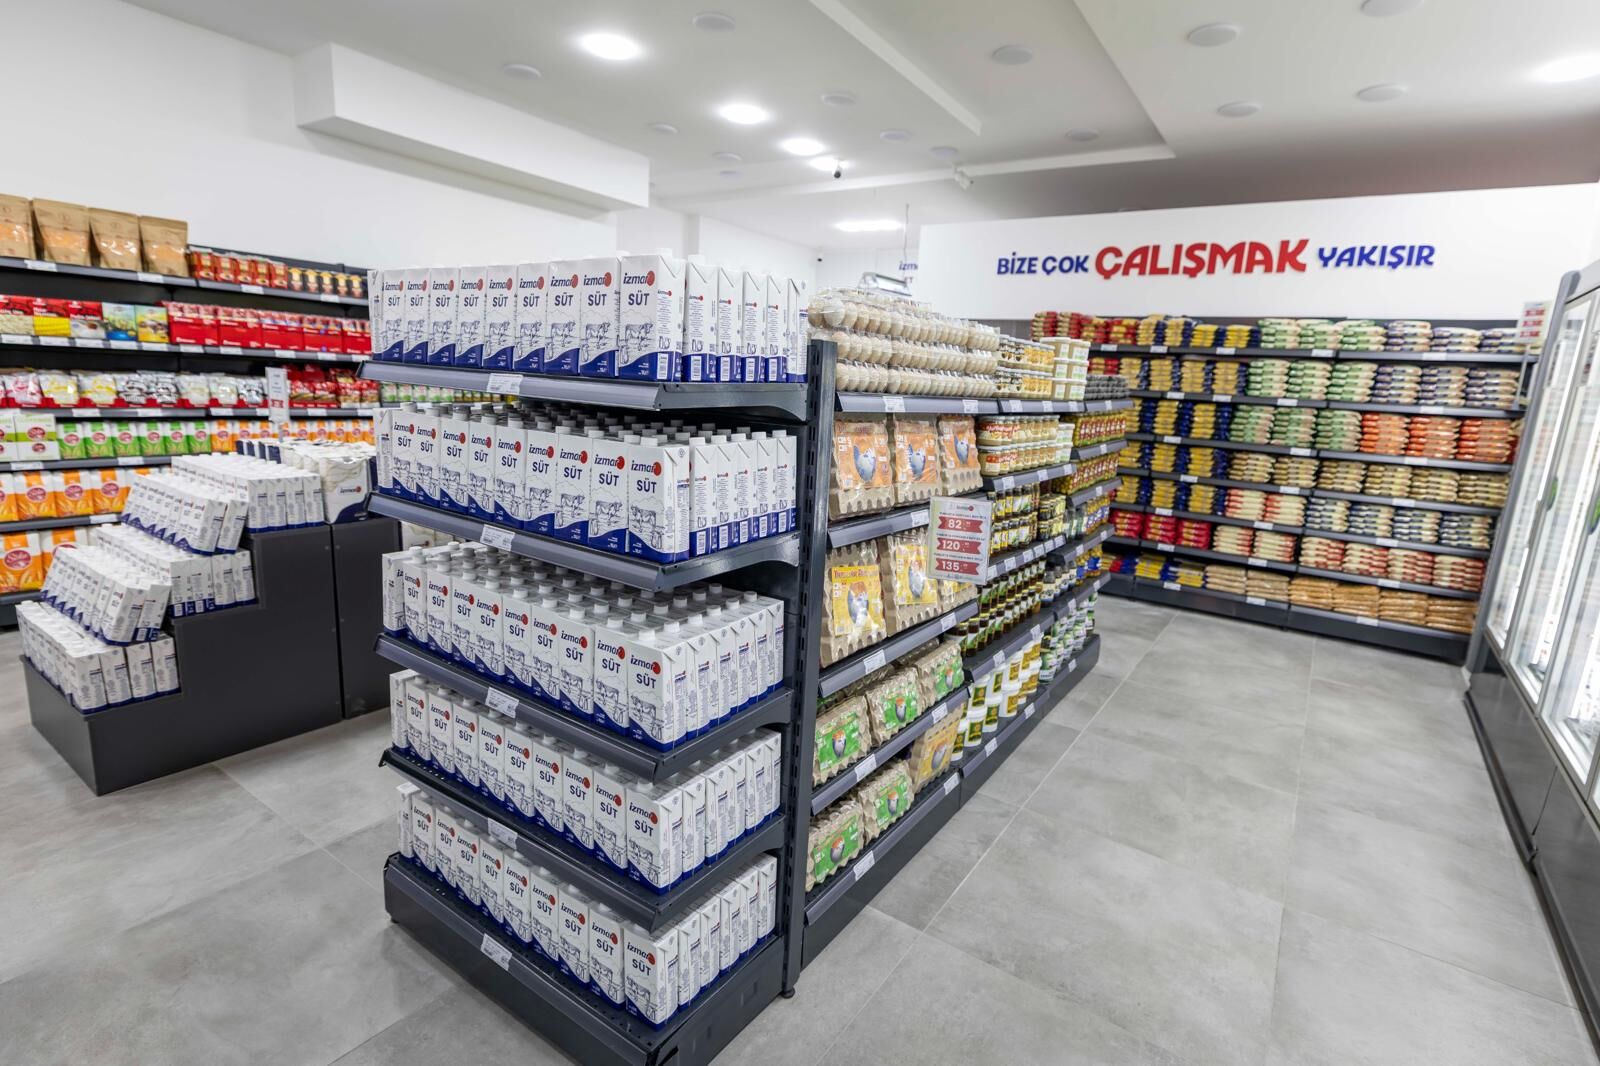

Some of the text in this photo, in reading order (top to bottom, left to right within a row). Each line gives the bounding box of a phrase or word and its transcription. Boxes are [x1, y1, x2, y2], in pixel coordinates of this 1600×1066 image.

[997, 238, 1435, 280] BİZE ÇOK ÇALIŞMAK YAKIŞIR
[388, 295, 400, 306] SÜT
[410, 295, 424, 306] SÜT
[436, 295, 450, 307] SÜT
[464, 294, 479, 307] SÜT
[493, 294, 508, 307] SÜT
[523, 294, 540, 307] SÜT
[555, 292, 573, 306] SÜT
[588, 291, 607, 306] SÜT
[628, 290, 650, 305] SÜT
[398, 436, 411, 447] SÜT
[421, 441, 434, 453] SÜT
[447, 445, 462, 458] SÜT
[474, 450, 488, 463] SÜT
[501, 455, 517, 468] SÜT
[532, 460, 549, 474] SÜT
[564, 466, 582, 480] SÜT
[599, 472, 619, 486] SÜT
[637, 478, 657, 493] SÜT
[948, 519, 962, 529] 82
[942, 540, 960, 550] 120
[942, 561, 960, 571] 135
[408, 587, 419, 599] SÜT
[432, 596, 445, 608] SÜT
[457, 604, 471, 617] SÜT
[480, 614, 495, 627] SÜT
[509, 624, 525, 638] SÜT
[537, 635, 553, 648] SÜT
[566, 646, 584, 662] SÜT
[602, 658, 621, 673] SÜT
[636, 673, 656, 689] SÜT
[411, 707, 422, 720] SÜT
[434, 718, 447, 731] SÜT
[459, 730, 472, 744] SÜT
[485, 742, 499, 756] SÜT
[511, 756, 526, 771] SÜT
[539, 770, 556, 785] SÜT
[570, 785, 586, 800] SÜT
[600, 801, 618, 819] SÜT
[417, 820, 429, 833] SÜT
[634, 820, 653, 837] SÜT
[440, 832, 452, 846] SÜT
[461, 850, 474, 864] SÜT
[486, 864, 498, 879] SÜT
[510, 881, 524, 897] SÜT
[537, 900, 552, 916] SÜT
[565, 919, 581, 936] SÜT
[596, 938, 614, 956] SÜT
[632, 958, 651, 976] SÜT
